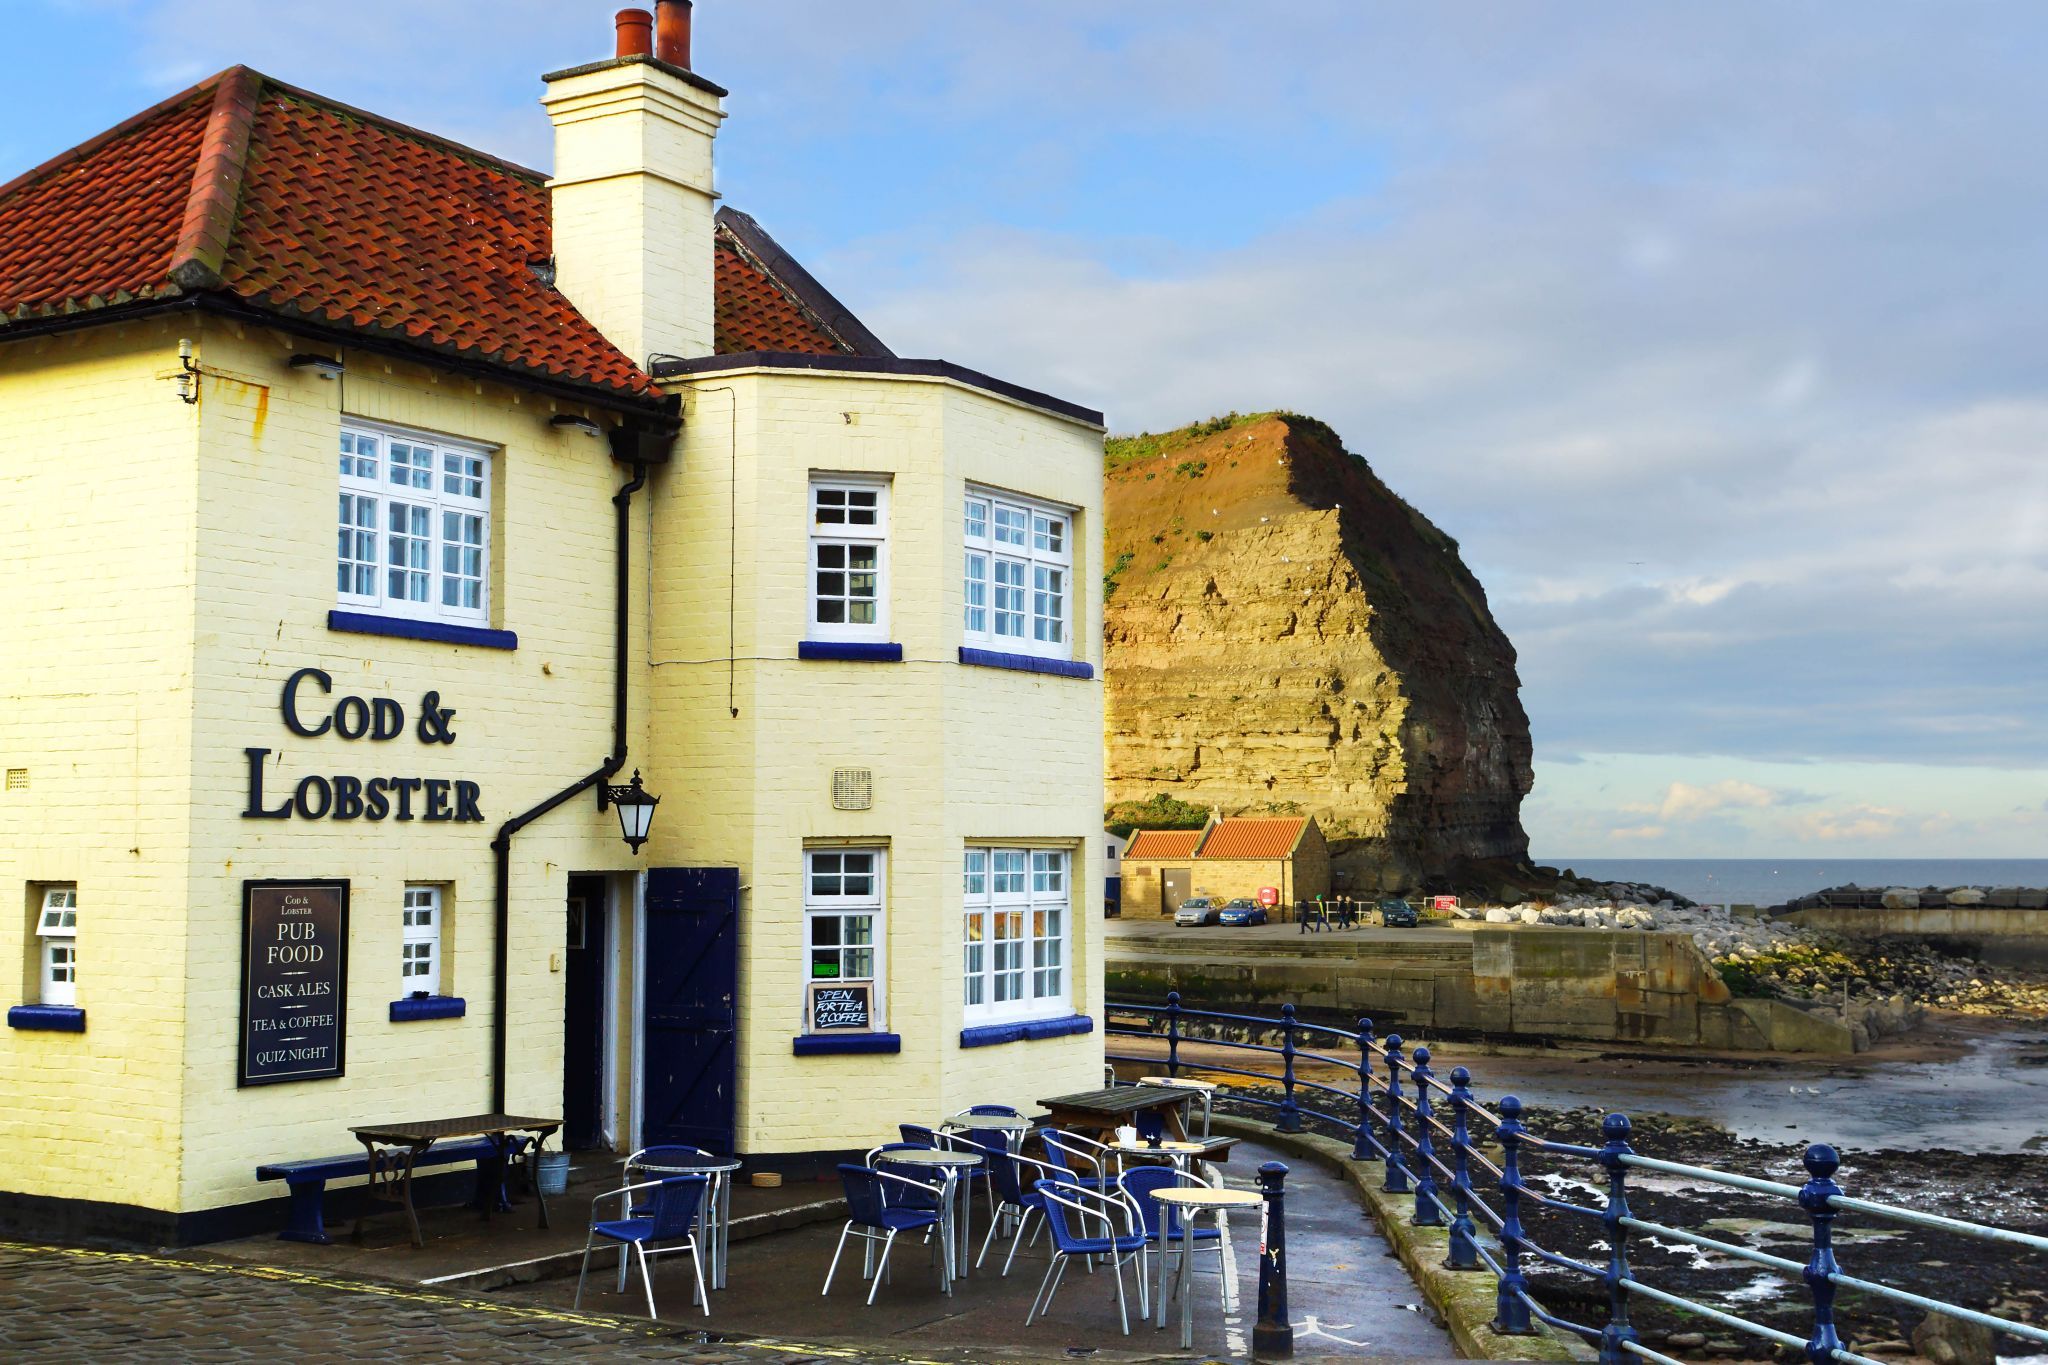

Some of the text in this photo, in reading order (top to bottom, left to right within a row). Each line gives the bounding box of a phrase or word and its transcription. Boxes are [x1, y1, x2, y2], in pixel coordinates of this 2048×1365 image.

[283, 668, 457, 744] COD &
[242, 747, 485, 821] LOBSTER
[285, 895, 301, 905] COD
[281, 906, 312, 916] LOBSTER
[277, 922, 315, 941] PUB
[267, 945, 324, 965] FOOD
[257, 982, 330, 999] CASK ALES
[817, 990, 854, 1000] OPEN
[815, 1001, 863, 1013] FOR TEA
[252, 1014, 334, 1032] TEA & COFFEE
[828, 1012, 868, 1023] COFFEE
[256, 1047, 329, 1066] QUIZ NIGHT
